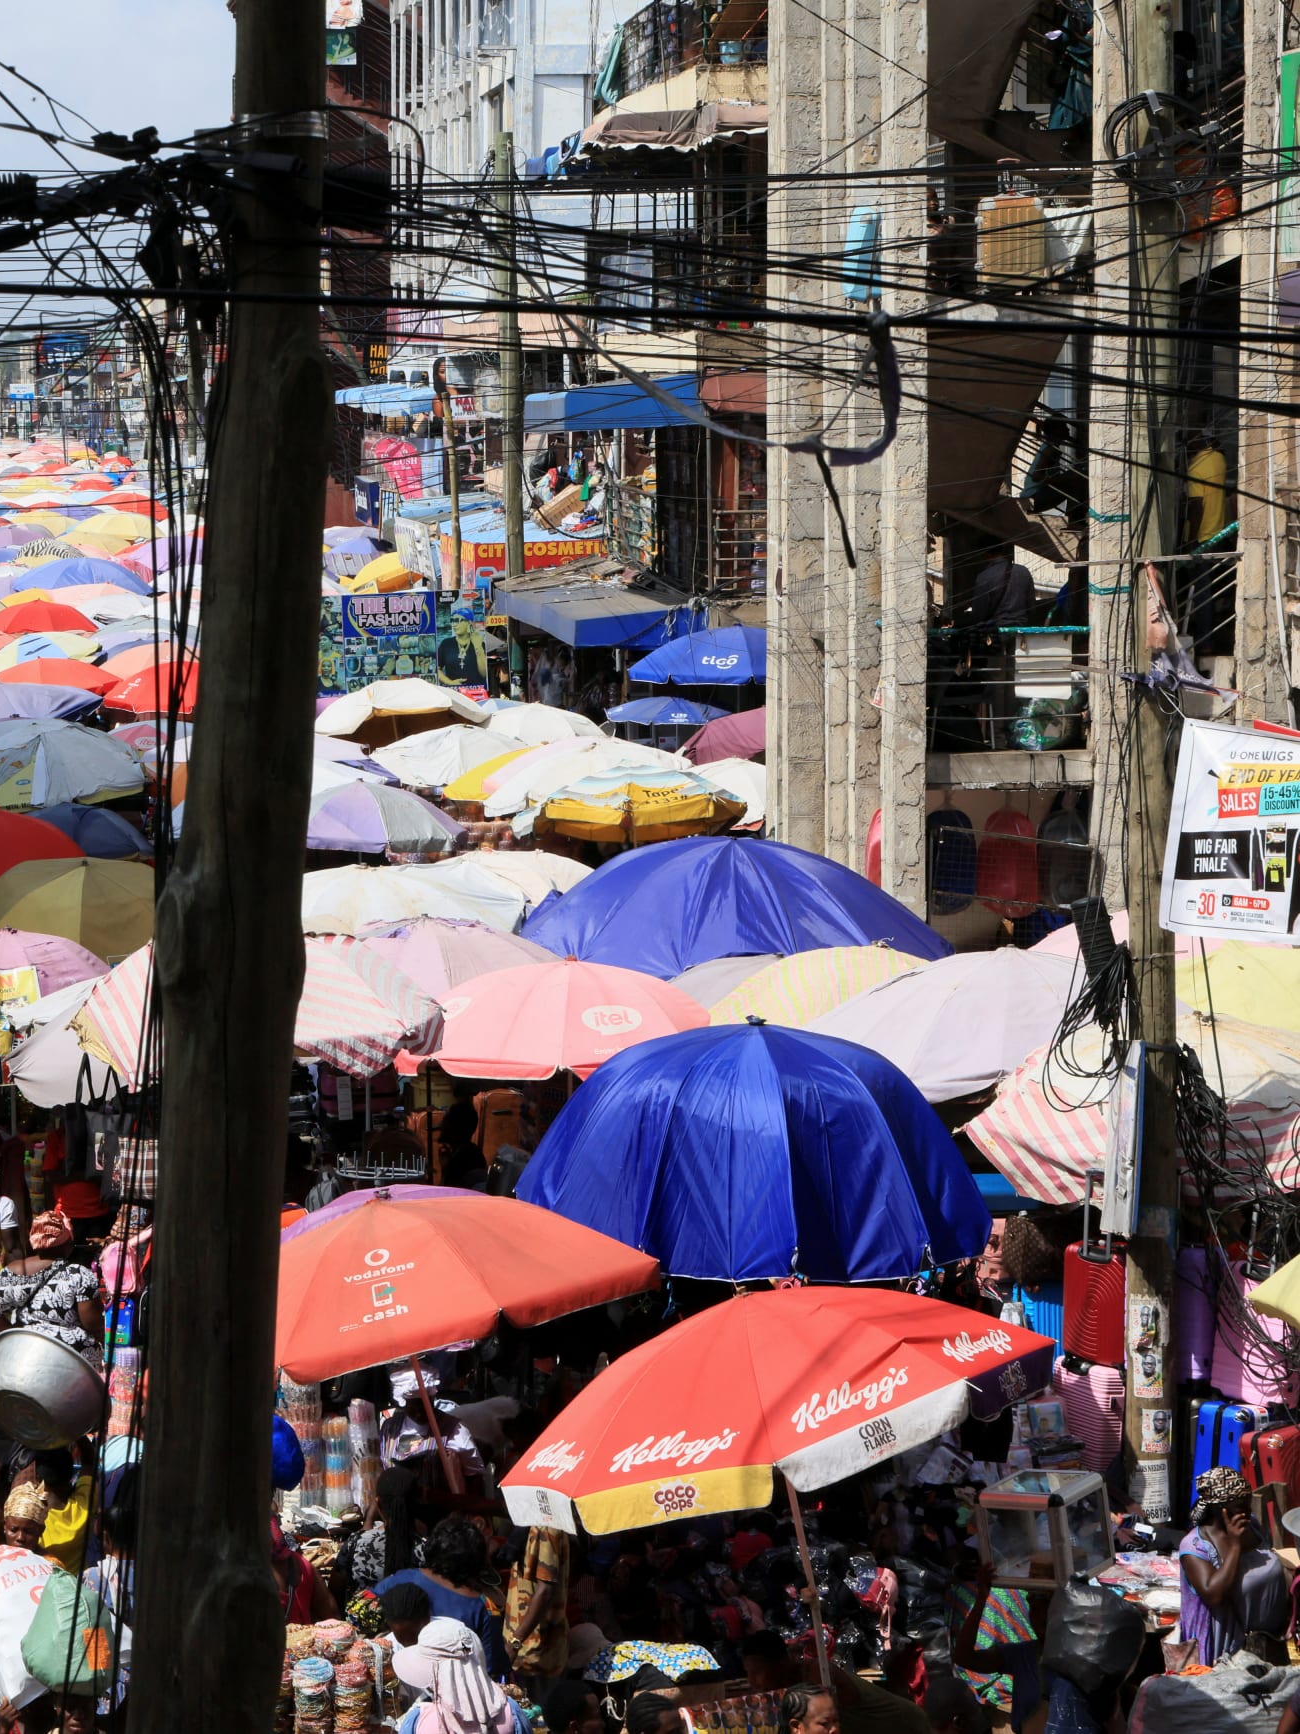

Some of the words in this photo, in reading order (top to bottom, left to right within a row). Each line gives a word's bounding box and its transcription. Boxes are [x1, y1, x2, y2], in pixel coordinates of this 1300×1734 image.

[352, 597, 385, 614] THE
[388, 595, 425, 613] BOY
[359, 613, 420, 628] FASHION
[383, 625, 420, 635] Jewellery
[702, 655, 739, 669] tigo
[1262, 751, 1293, 761] WIGS
[1228, 769, 1255, 783] END
[1257, 769, 1275, 782] OF
[1221, 792, 1256, 811] SALES
[1265, 798, 1300, 811] DISCOUNT
[1194, 839, 1213, 855] WIG
[1214, 838, 1237, 854] FAIR
[1194, 857, 1228, 873] FINALE
[1198, 893, 1216, 916] 30
[593, 1010, 633, 1027] itel
[343, 1262, 415, 1282] vodafone
[362, 1304, 409, 1323] cash
[942, 1328, 1012, 1363] Kellogg's
[791, 1366, 909, 1433] Kellogg's
[859, 1416, 892, 1440] CORN
[609, 1428, 736, 1473] Kellogg's
[864, 1430, 897, 1452] FLAKES
[527, 1440, 584, 1480] Kellogg's
[654, 1485, 696, 1504] COCO
[664, 1499, 693, 1516] pops
